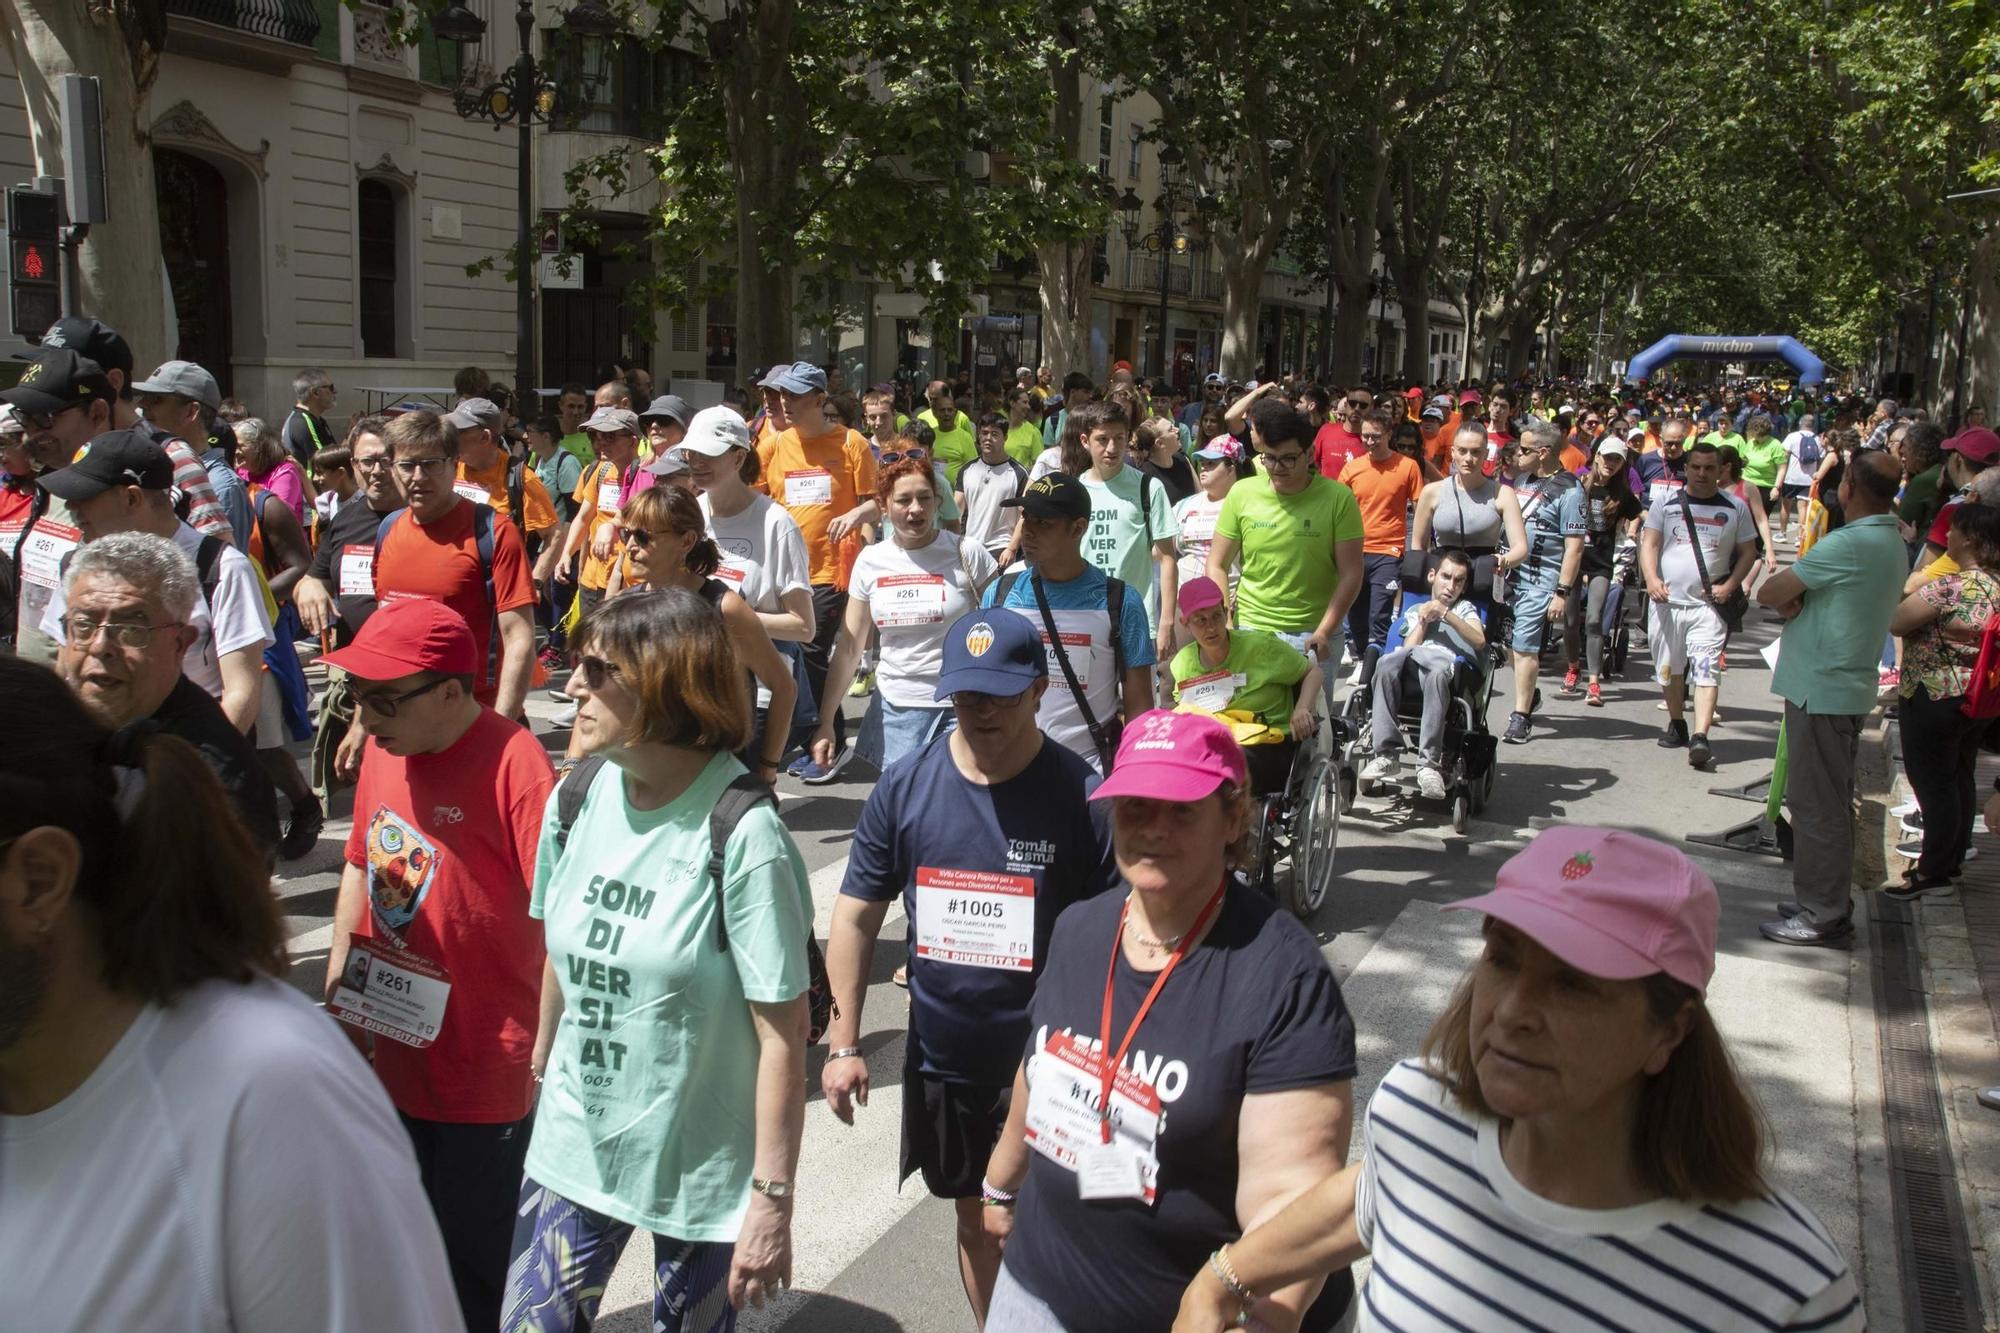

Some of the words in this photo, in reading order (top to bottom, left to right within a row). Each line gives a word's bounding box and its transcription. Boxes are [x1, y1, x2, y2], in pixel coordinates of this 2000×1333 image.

[1702, 340, 1754, 353] mychip
[1090, 509, 1118, 521] SOM
[1096, 525, 1110, 536] DI
[1090, 539, 1117, 550] VER
[1096, 554, 1109, 565] SI
[896, 589, 919, 599] #261
[583, 874, 657, 920] SOM
[947, 898, 1004, 918] #1005
[585, 917, 626, 957] DI
[927, 946, 949, 959] SOM
[951, 950, 1022, 967] DIVERSITAT
[376, 969, 412, 995] #261
[567, 953, 632, 999] VER
[578, 996, 614, 1031] SI
[340, 1009, 363, 1025] SOM
[364, 1018, 425, 1047] DIVERSITAT
[580, 1037, 628, 1072] AT
